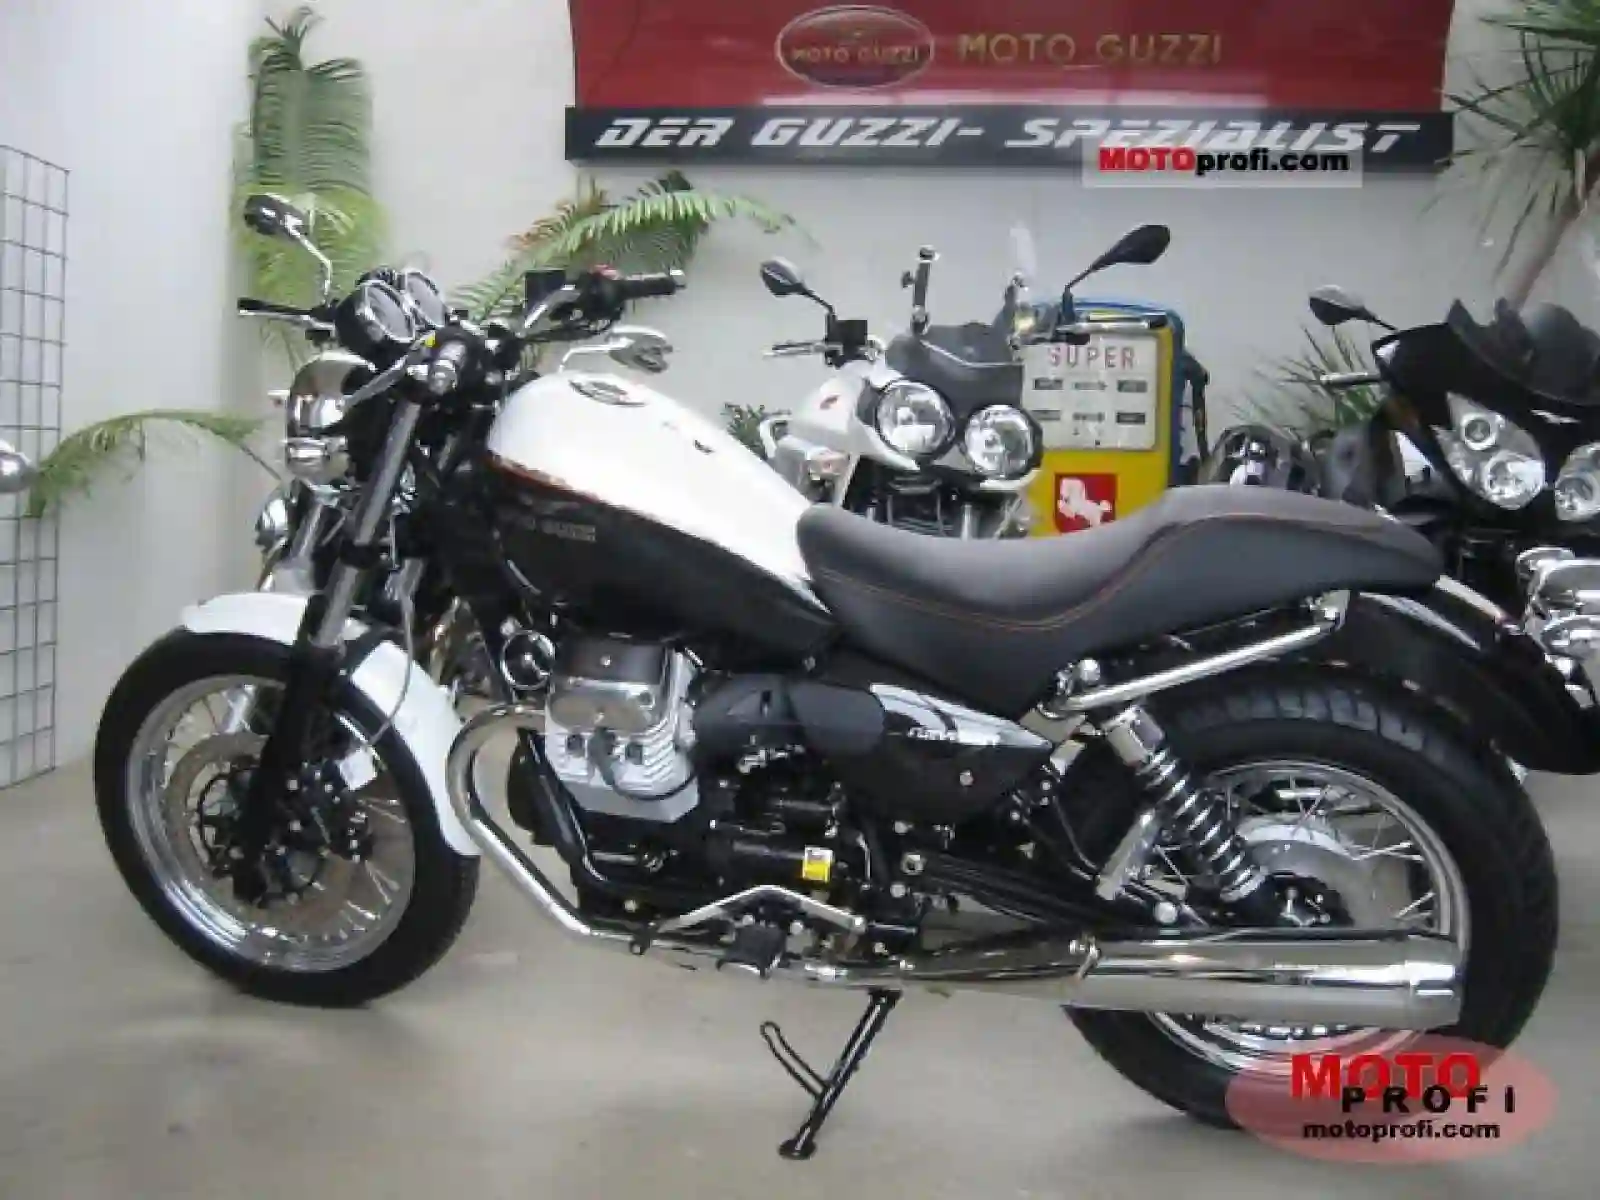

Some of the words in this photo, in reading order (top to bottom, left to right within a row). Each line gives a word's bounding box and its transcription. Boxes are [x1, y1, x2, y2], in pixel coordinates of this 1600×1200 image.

[792, 46, 850, 63] MOTO
[960, 34, 1075, 62] MOTO
[1096, 34, 1222, 63] GUZZI
[596, 118, 735, 146] DER
[750, 117, 985, 146] GUZZI-
[1004, 118, 1421, 152] SPEZIALIST
[1048, 346, 1135, 369] SUPER
